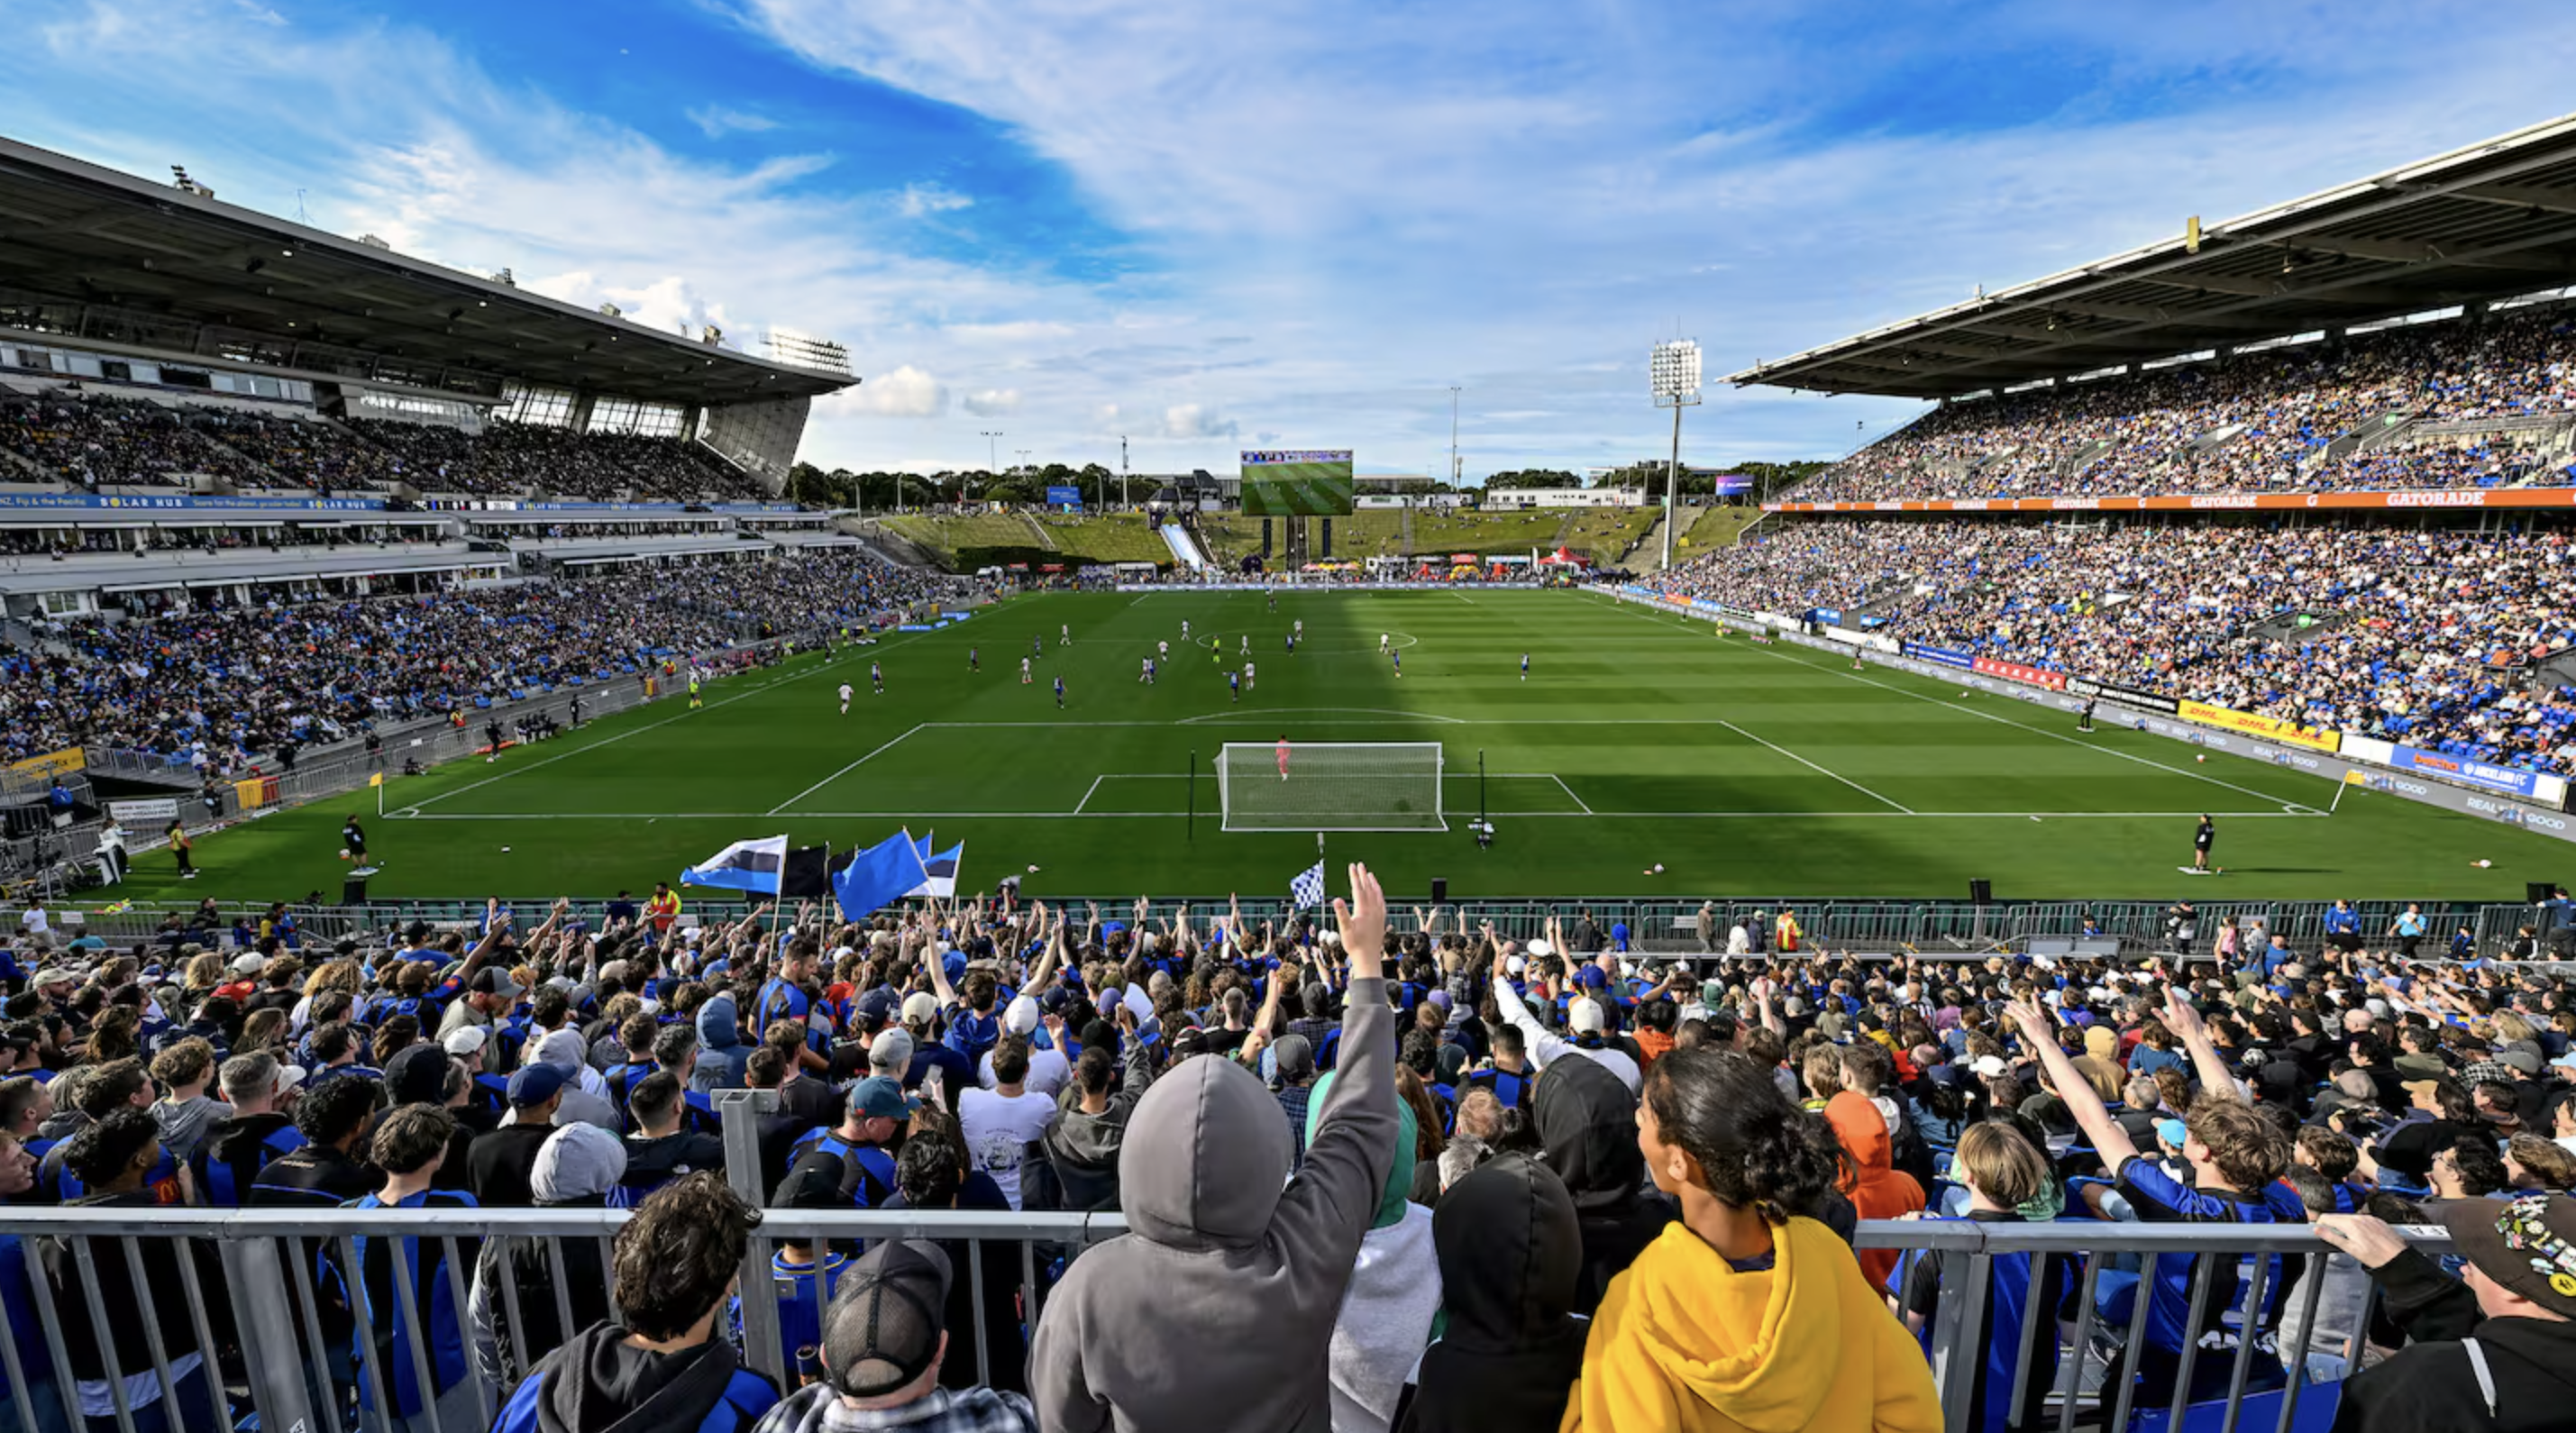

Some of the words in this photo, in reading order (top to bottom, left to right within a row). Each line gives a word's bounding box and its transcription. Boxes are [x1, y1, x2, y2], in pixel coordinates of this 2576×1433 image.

[100, 497, 149, 507] SOLAR
[156, 498, 182, 507] HUB
[2052, 498, 2100, 509] GATORADE
[2138, 497, 2146, 508] G
[2190, 496, 2257, 508] GATORADE
[2307, 495, 2318, 507] G
[2387, 491, 2486, 507] GATORADE
[2189, 707, 2217, 719] DHL
[2238, 717, 2267, 731] DHL
[2253, 746, 2275, 759] REAL
[2292, 755, 2318, 769] GOOD
[2515, 773, 2528, 787] FC
[2396, 780, 2427, 795] GOOD
[2467, 798, 2498, 814] REAL
[2526, 813, 2565, 830] GOOD
